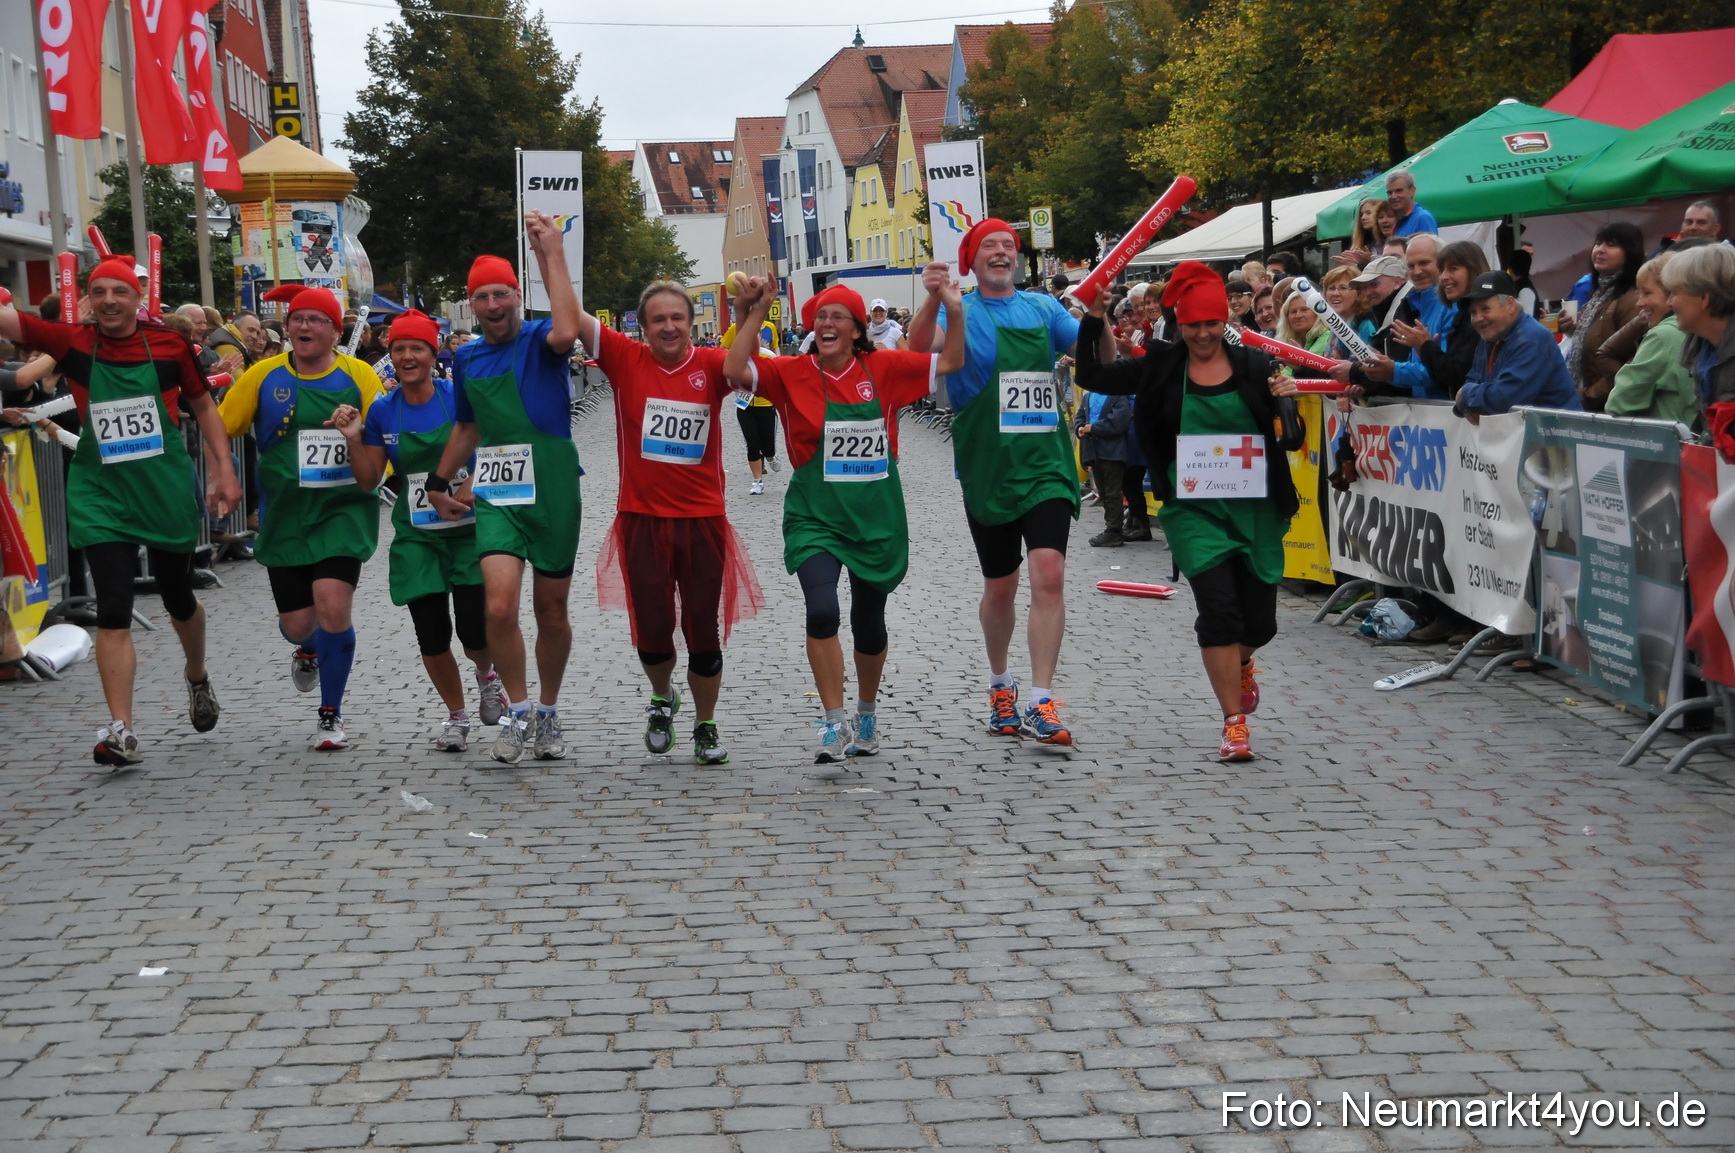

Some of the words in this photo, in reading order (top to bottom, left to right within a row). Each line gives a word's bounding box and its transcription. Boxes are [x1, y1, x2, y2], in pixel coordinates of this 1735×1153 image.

[528, 177, 579, 191] swn
[1105, 255, 1127, 279] Audi
[1125, 234, 1146, 256] BKK
[64, 292, 72, 308] BKK
[1326, 313, 1350, 339] BMW
[1007, 387, 1052, 409] 2196
[113, 404, 146, 413] Neumarkt
[647, 404, 670, 412] PARTL
[671, 407, 702, 416] Neumarkt
[99, 412, 154, 440] 2153
[1022, 415, 1043, 424] Frank
[650, 414, 705, 441] 2087
[108, 442, 151, 454] Wolfgang
[665, 444, 685, 456] Reto
[832, 435, 884, 457] 2224
[320, 470, 343, 480] Ralph
[478, 460, 526, 483] 2067
[843, 463, 875, 474] Brigitte
[1205, 480, 1237, 491] Zwerg
[1243, 480, 1248, 489] 7
